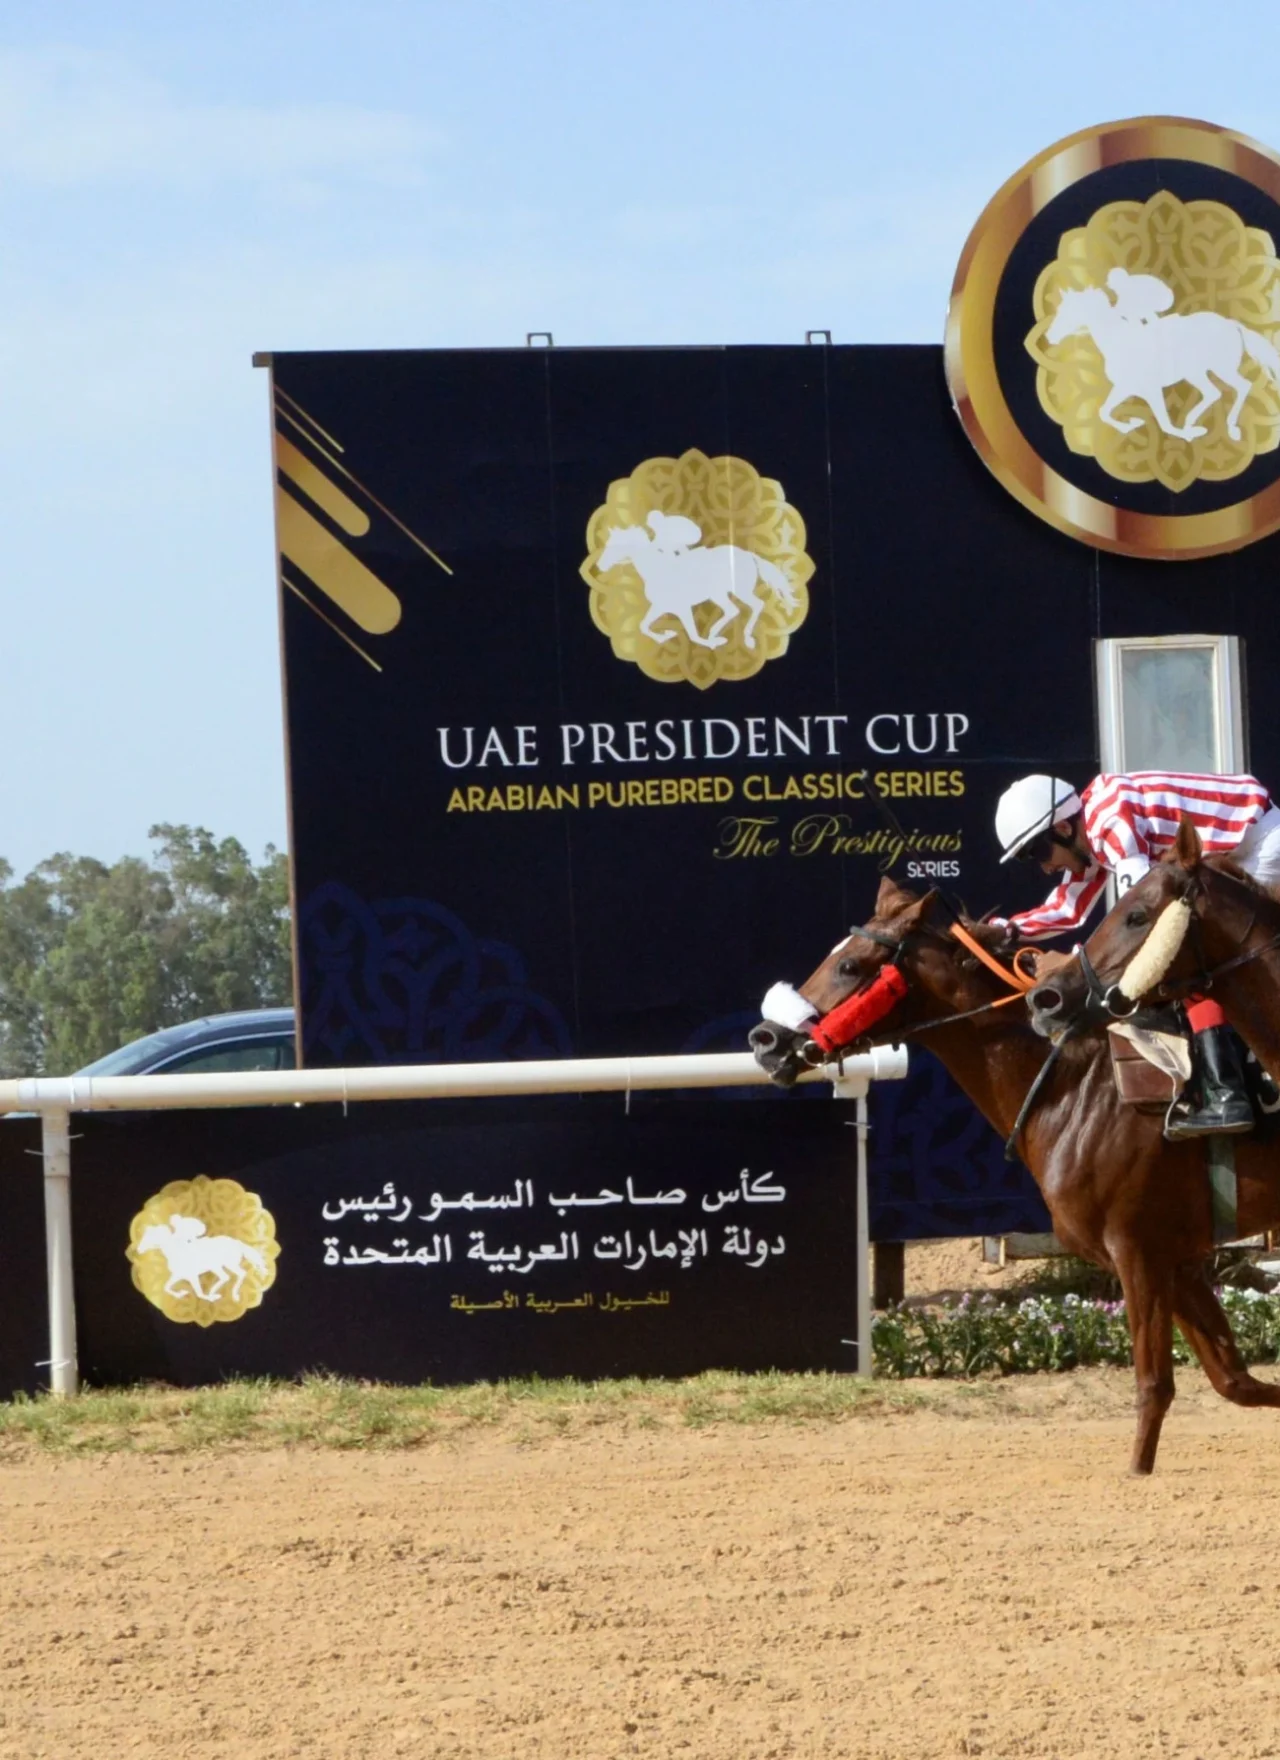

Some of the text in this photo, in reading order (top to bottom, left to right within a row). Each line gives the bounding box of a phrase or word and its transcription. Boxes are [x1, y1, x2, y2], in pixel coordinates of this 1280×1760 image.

[437, 713, 969, 768] UAE PRESIDENT CUP
[446, 770, 965, 813] ARABIAN PUREBRED CLASSIC SERIES
[713, 814, 962, 872] The Prestigious
[907, 860, 961, 878] SERIES
[321, 1168, 786, 1223] كأس صاحب السمو رئيس
[322, 1225, 786, 1274] دولة الإمارات العربية المتحدة
[450, 1290, 670, 1315] للخيول العربية الأصيلة
